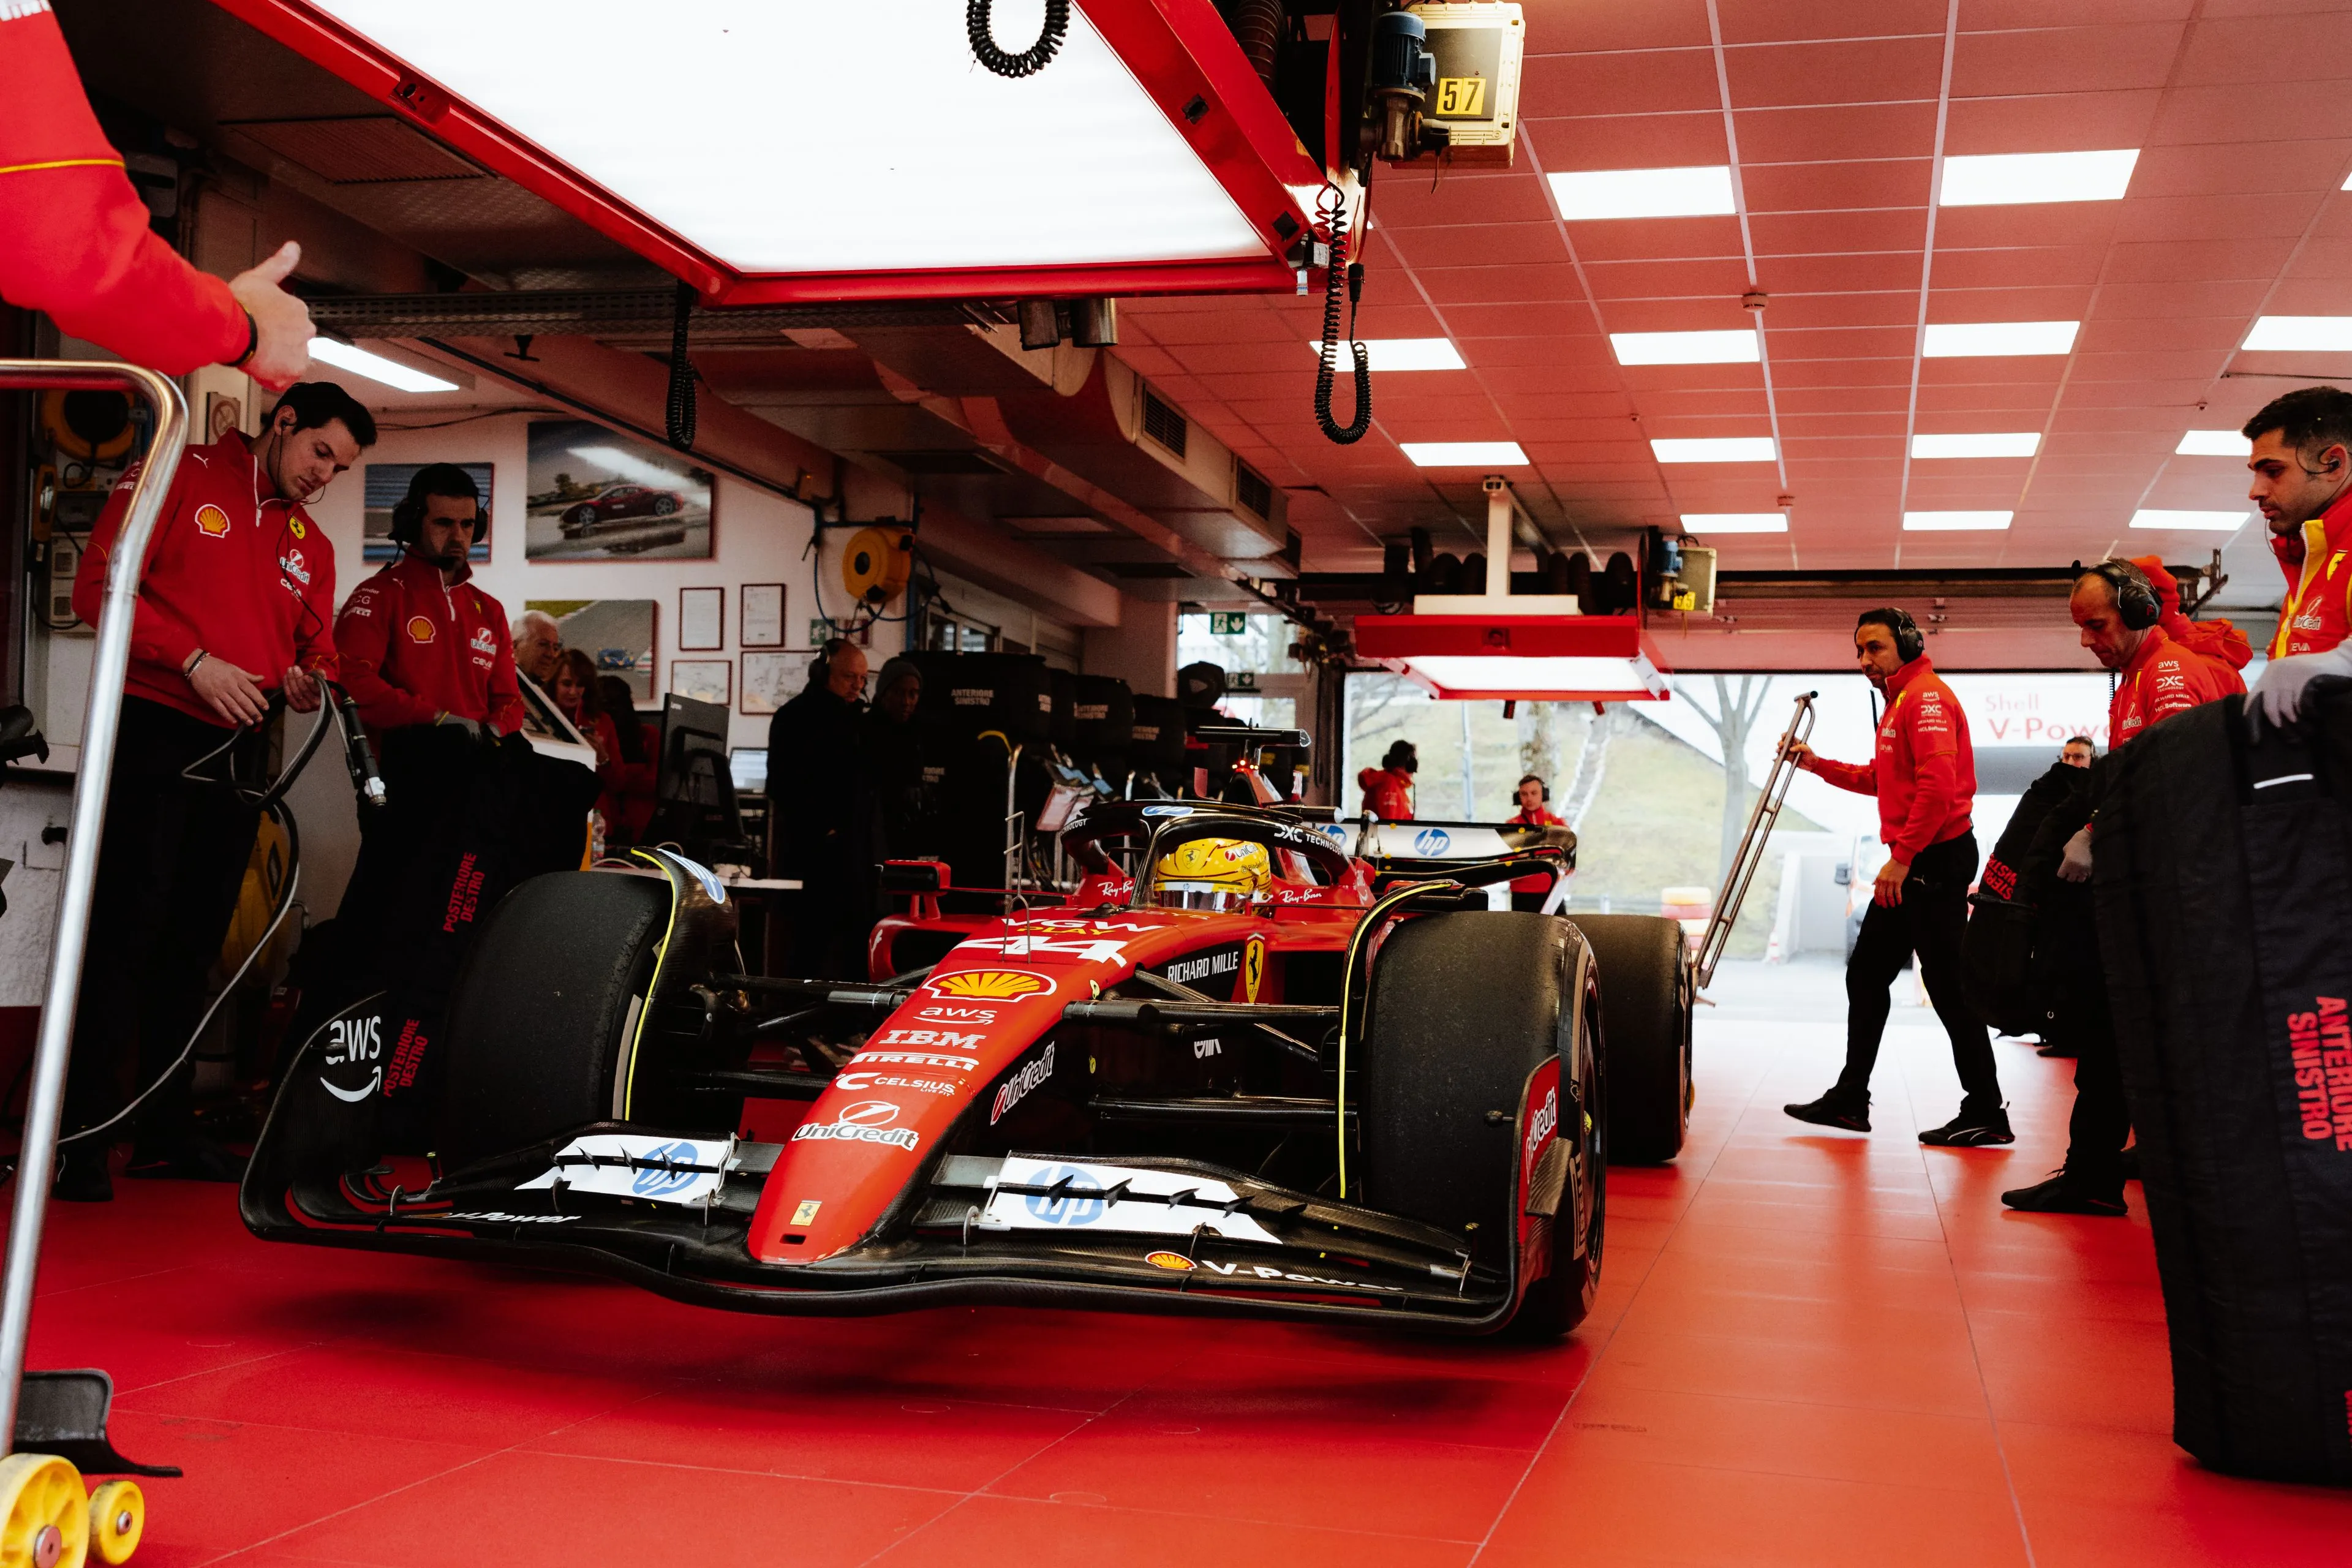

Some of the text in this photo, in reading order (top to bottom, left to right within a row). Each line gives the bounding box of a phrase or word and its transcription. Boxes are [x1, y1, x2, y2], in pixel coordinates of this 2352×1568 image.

[1443, 81, 1480, 111] 57
[2156, 676, 2184, 689] DXC
[951, 689, 994, 698] ANTERIORE
[1986, 693, 2039, 712] Shell
[1921, 704, 1942, 714] DXC
[1273, 823, 1304, 843] DXC
[1416, 828, 1449, 857] hp
[443, 852, 477, 933] POSTERIORE
[460, 871, 485, 922] DESTRO
[1098, 881, 1134, 897] Ray-Ba
[1279, 889, 1322, 903] Ray-Ban
[1001, 918, 1166, 932] VGW
[1017, 926, 1117, 935] PLAY
[952, 935, 1129, 968] 44
[1167, 951, 1238, 983] RICHARD MILLE
[919, 1007, 998, 1019] aws
[326, 1016, 381, 1065] aws
[878, 1030, 987, 1050] IBM
[399, 1036, 428, 1087] DESTRO
[850, 1052, 979, 1071] PIRELLI
[2286, 1012, 2333, 1140] SINISTRO
[2316, 996, 2352, 1152] ANTERIORE
[874, 1077, 956, 1093] CELSIUS
[793, 1123, 919, 1151] UniCredit
[1201, 1259, 1404, 1291] V-Power
